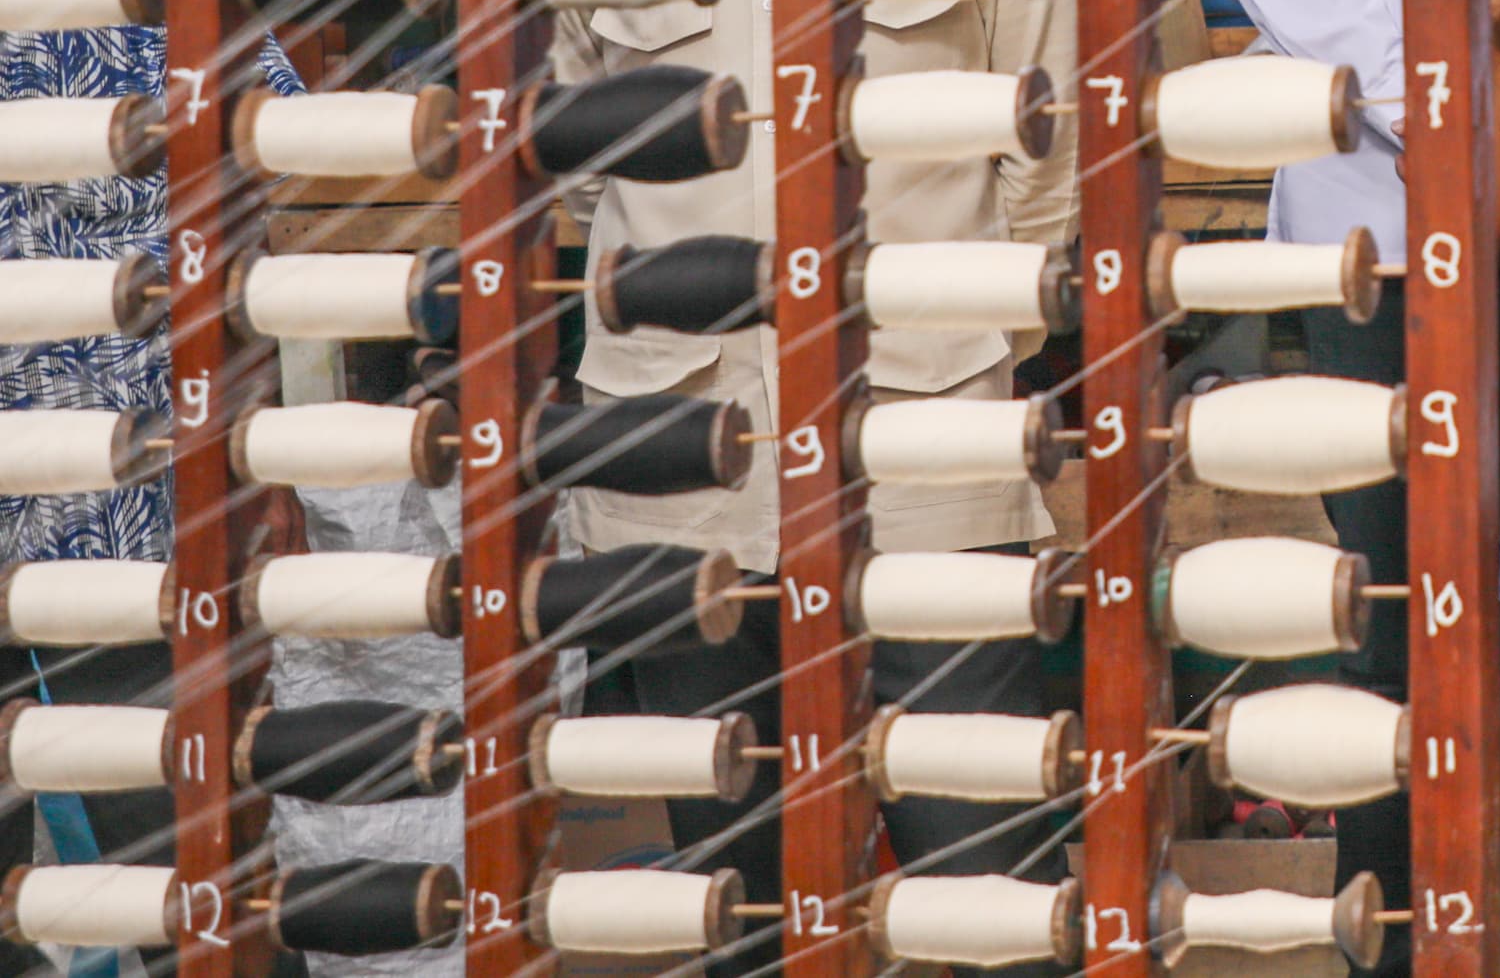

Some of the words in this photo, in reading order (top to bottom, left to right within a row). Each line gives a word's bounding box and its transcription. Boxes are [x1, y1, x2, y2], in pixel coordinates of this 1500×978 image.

[169, 66, 210, 126] 7
[777, 64, 822, 130] 7
[1086, 75, 1127, 126] 7
[1416, 61, 1450, 129] 7
[471, 88, 506, 152] 7
[180, 229, 206, 284] 8
[471, 260, 504, 296] 8
[788, 247, 820, 299] 8
[1093, 249, 1122, 295] 8
[1422, 231, 1460, 288] 8
[180, 368, 210, 427] 9
[469, 419, 503, 468] 9
[1090, 406, 1126, 460] 9
[1421, 389, 1459, 458] 9
[784, 425, 825, 479] 9
[180, 587, 219, 636] 10
[784, 577, 830, 622] 10
[1095, 568, 1132, 607] 10
[1421, 572, 1464, 638] 10
[183, 733, 206, 782] 11
[465, 736, 498, 777] 11
[789, 733, 819, 771] 11
[1088, 749, 1126, 795] 11
[1427, 736, 1457, 779] 11
[181, 880, 230, 946] 12
[467, 888, 512, 934] 12
[784, 889, 839, 935] 12
[1086, 902, 1141, 951] 12
[1425, 887, 1485, 934] 12
